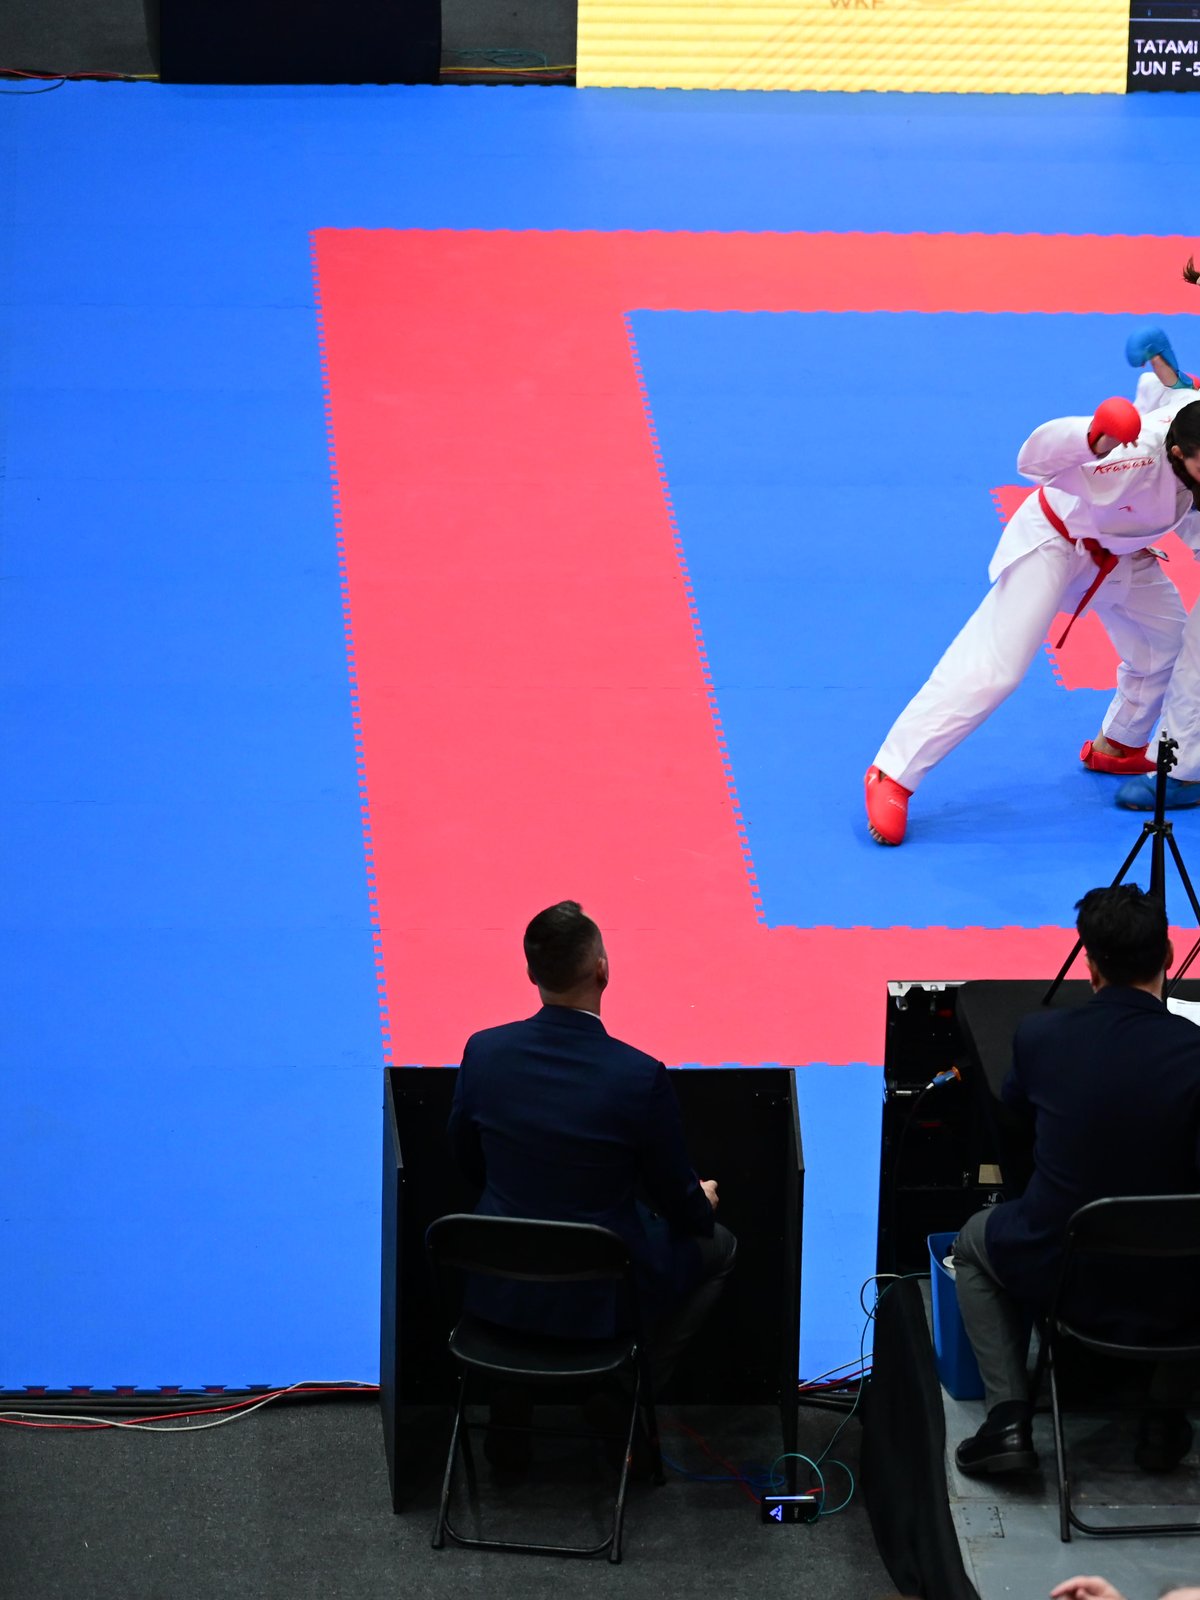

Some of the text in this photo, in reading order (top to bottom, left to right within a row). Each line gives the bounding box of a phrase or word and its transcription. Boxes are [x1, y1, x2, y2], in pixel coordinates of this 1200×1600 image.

[1134, 39, 1198, 54] TATAMI
[1132, 61, 1166, 76] JUN
[1171, 61, 1181, 75] F
